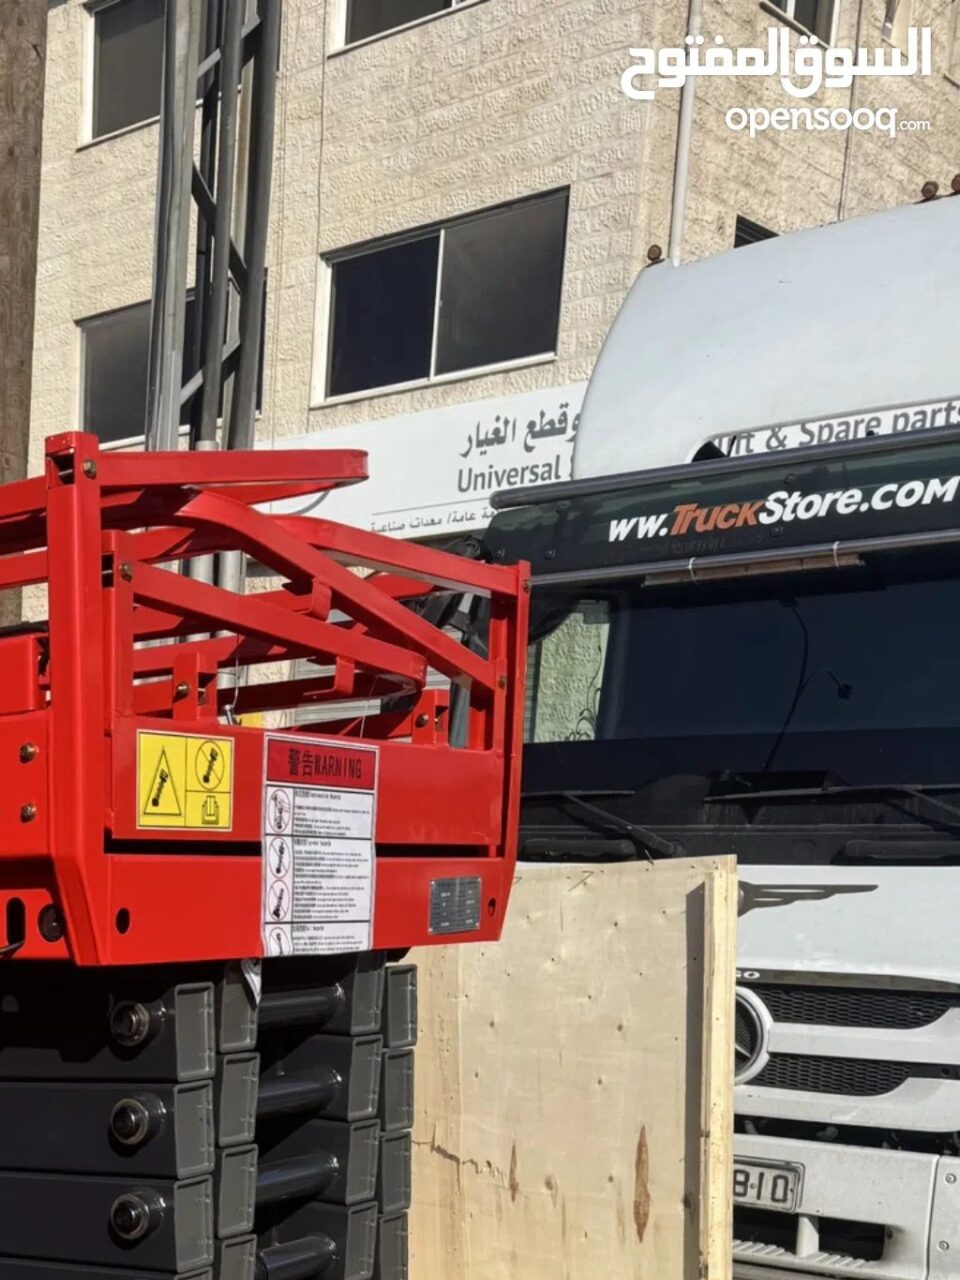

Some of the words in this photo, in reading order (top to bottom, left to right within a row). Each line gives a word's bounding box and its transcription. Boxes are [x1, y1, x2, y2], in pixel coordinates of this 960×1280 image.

[458, 454, 561, 493] Universal
[766, 427, 788, 450] &
[799, 416, 882, 448] Spare
[891, 401, 960, 435] part
[459, 414, 517, 458] الغيار
